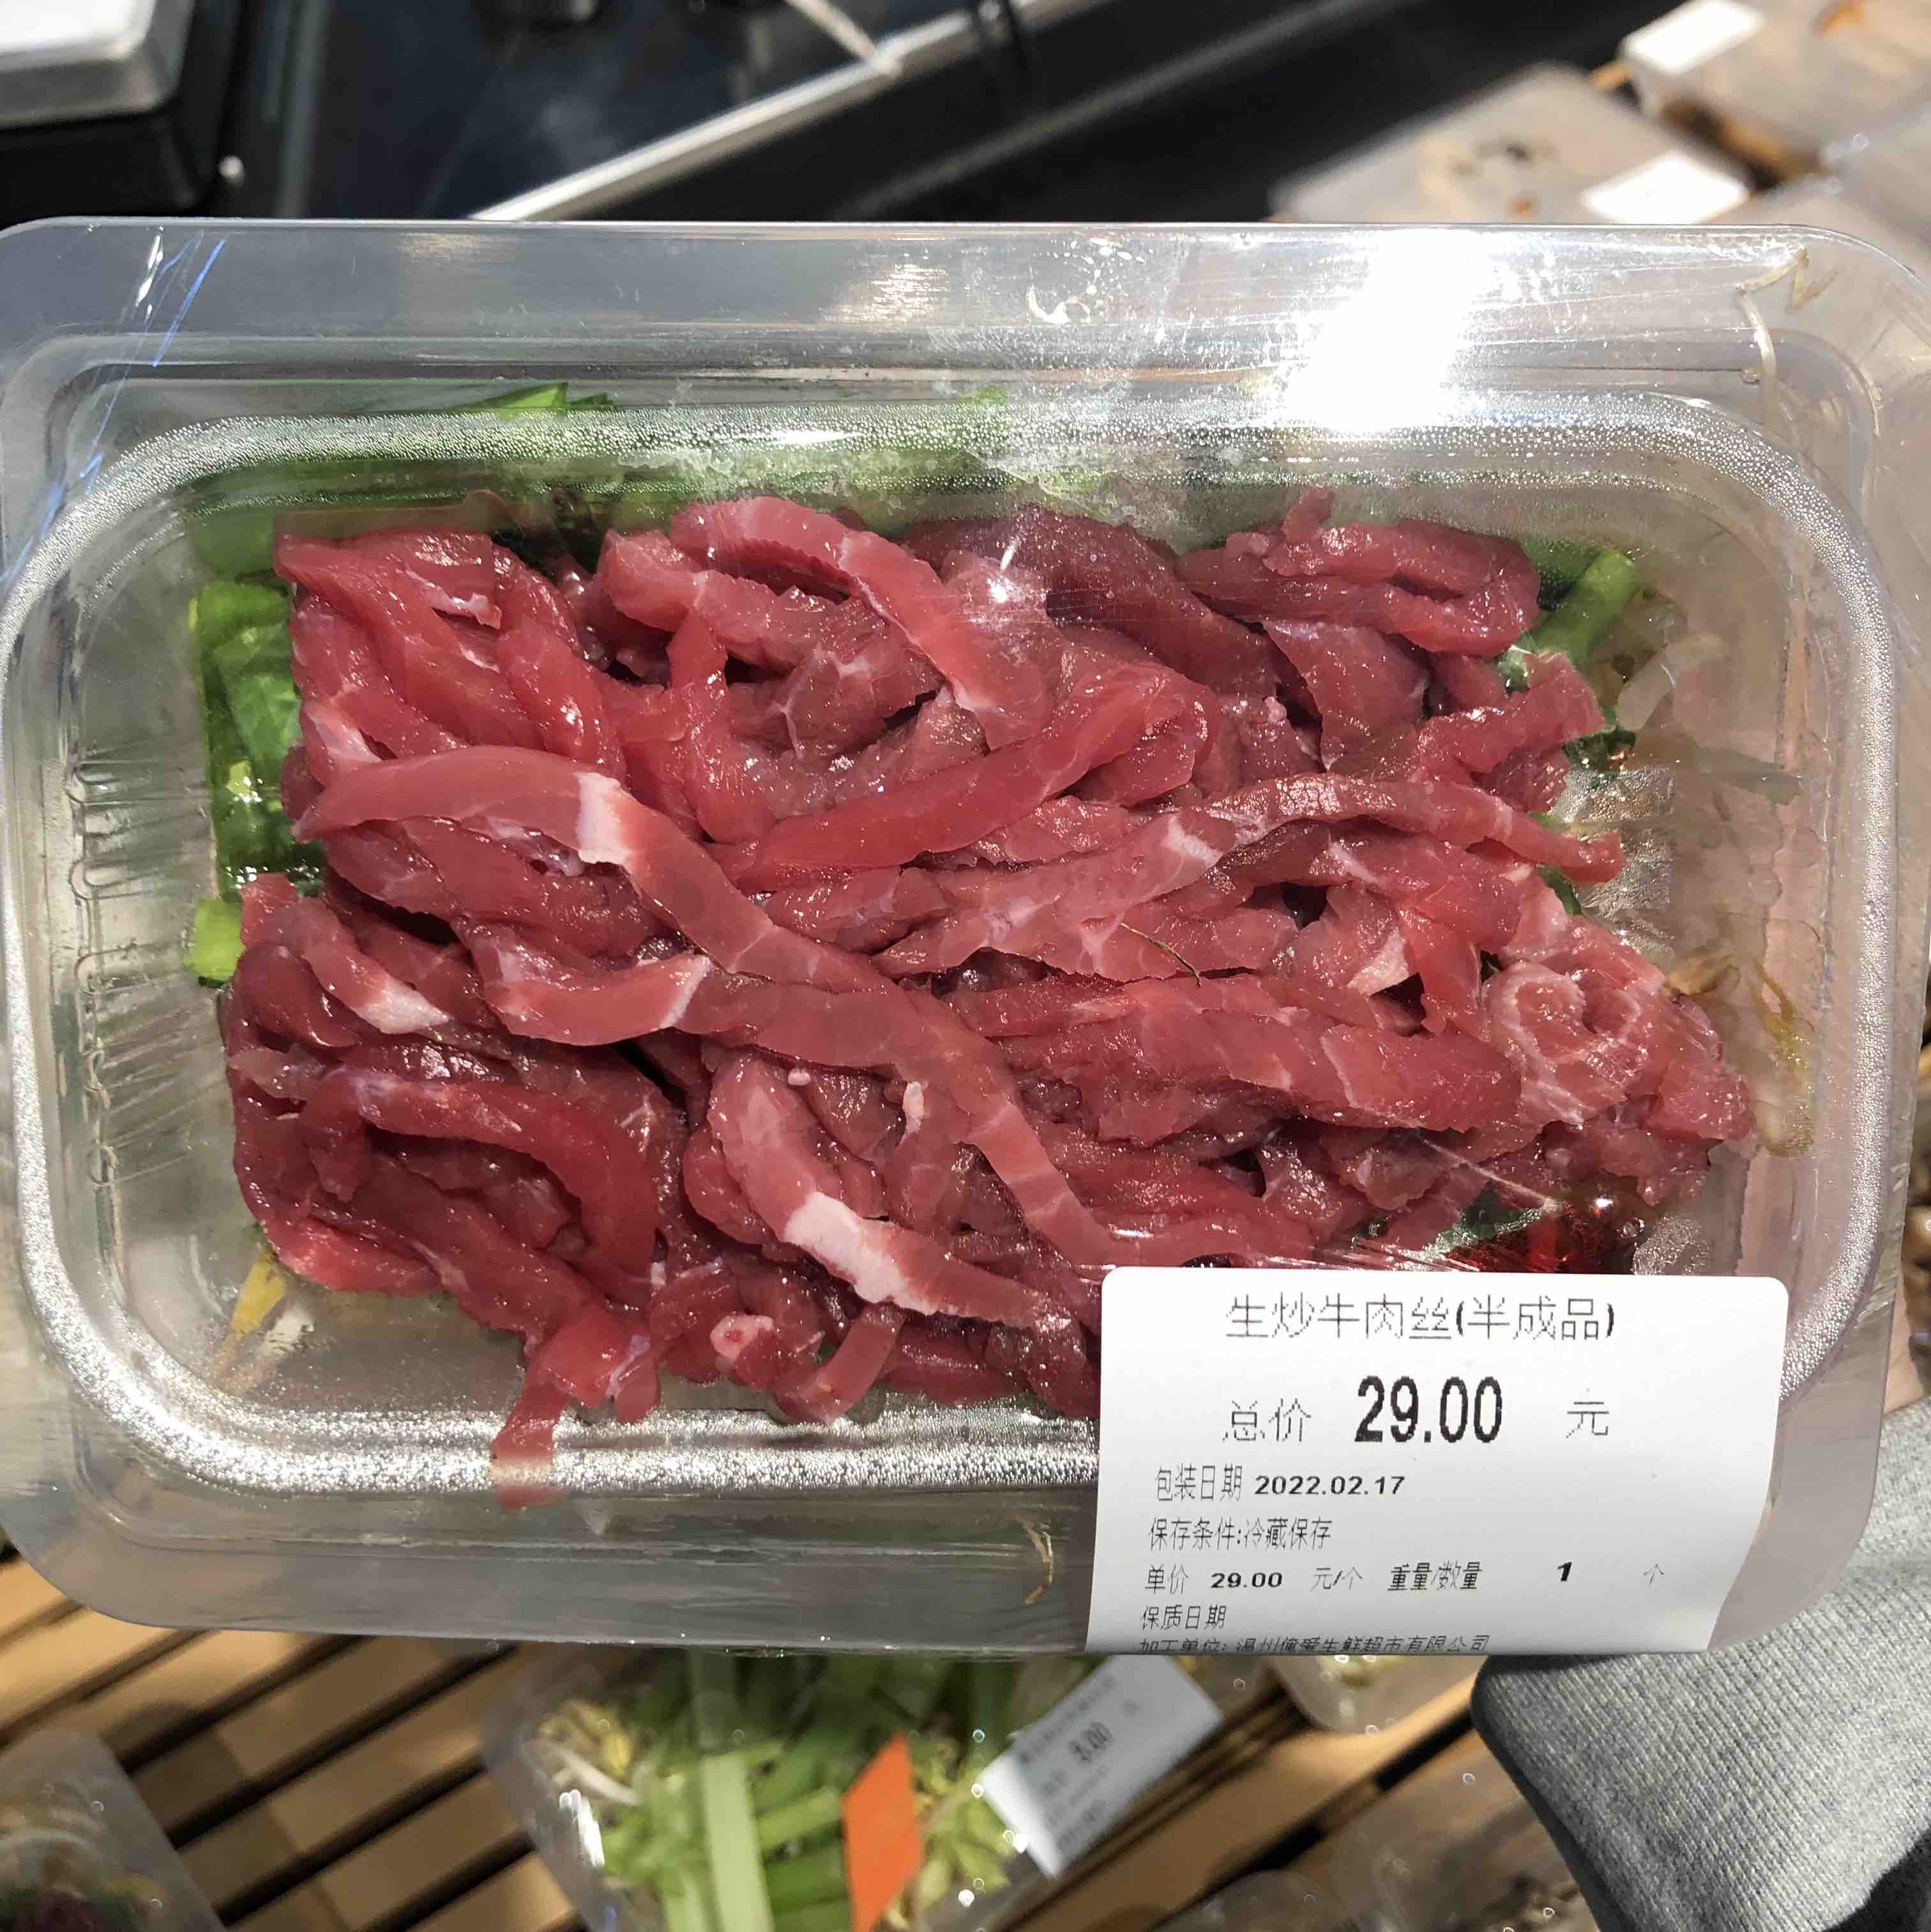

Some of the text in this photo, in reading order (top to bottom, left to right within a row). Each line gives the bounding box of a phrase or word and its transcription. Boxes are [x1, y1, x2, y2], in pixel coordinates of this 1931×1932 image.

[1225, 1291, 1616, 1341] 生炒牛肉丝(半成品)
[1222, 1375, 1610, 1443] 总价 29.00 元
[1155, 1463, 1405, 1502] 包装日期 2022.02.17
[1150, 1516, 1333, 1551] 保存条件:冷藏保存
[1145, 1560, 1665, 1595] 单价 29.00 元/个 重量/数量 1 个
[1141, 1604, 1227, 1631] 保质日期
